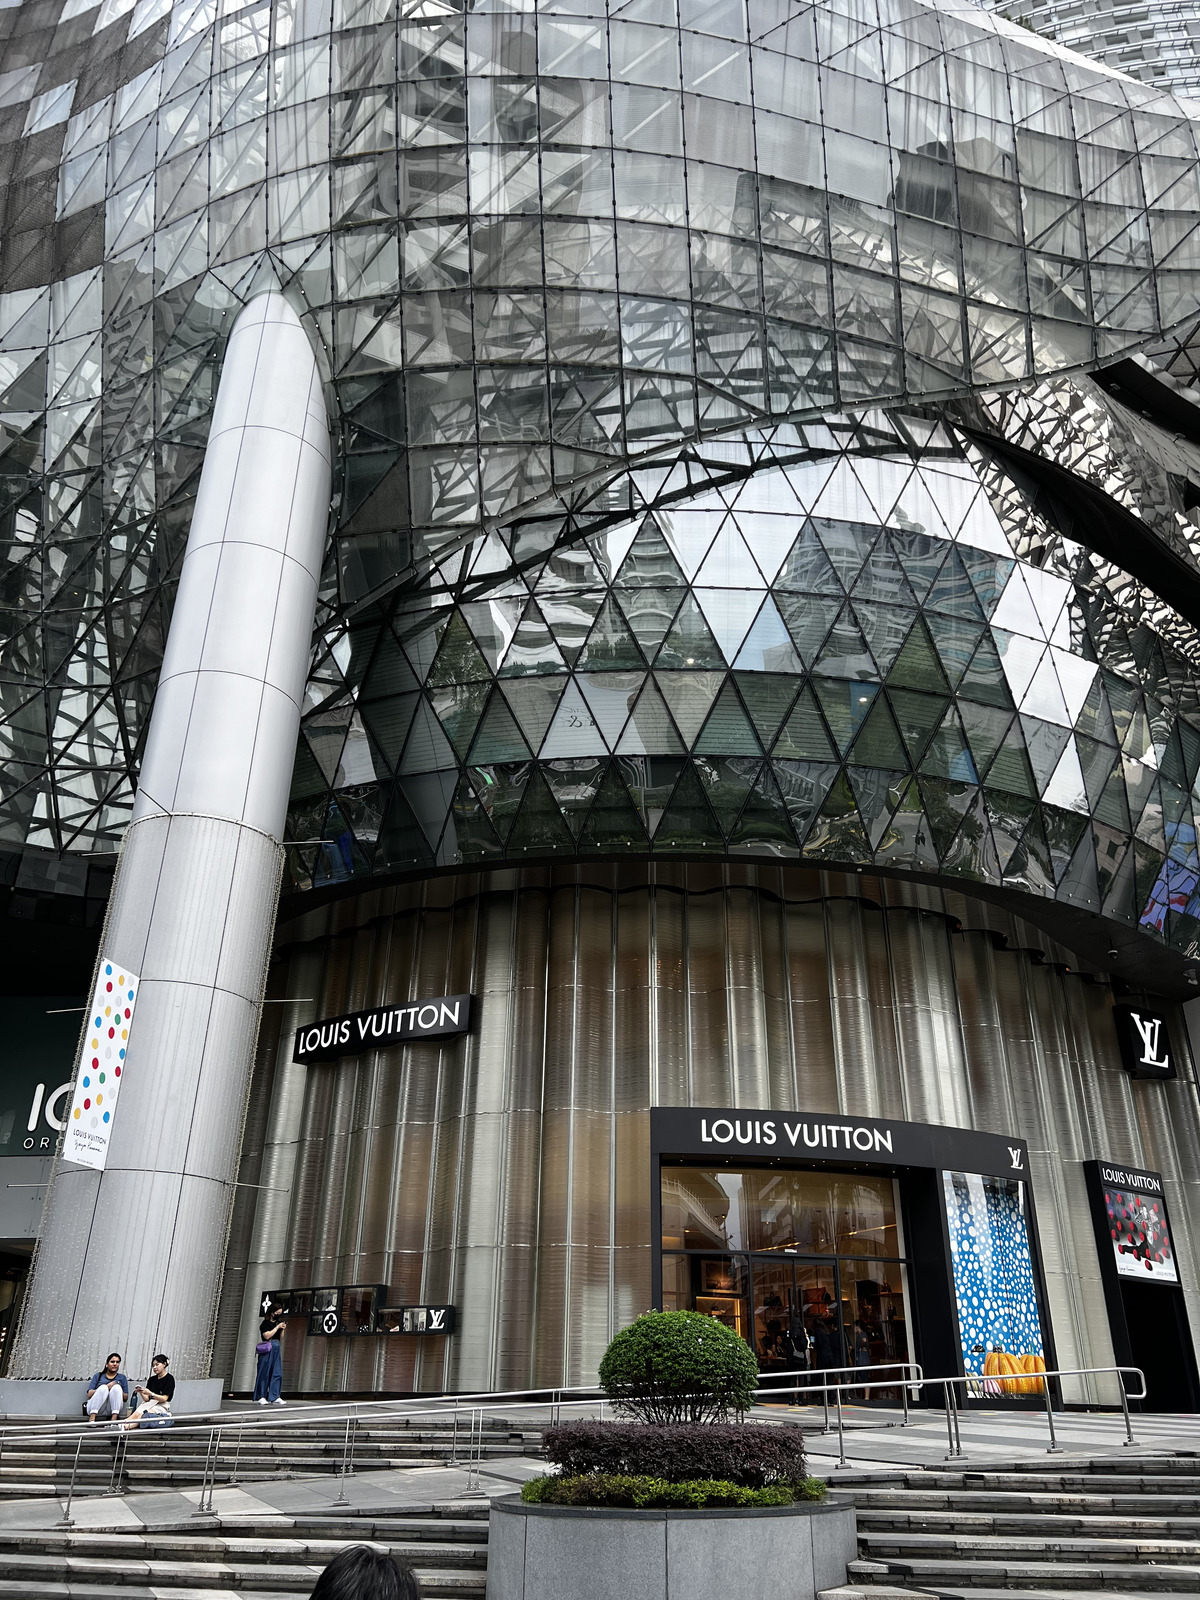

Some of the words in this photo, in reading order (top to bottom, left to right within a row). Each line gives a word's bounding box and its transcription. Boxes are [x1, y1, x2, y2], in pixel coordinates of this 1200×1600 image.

[298, 1019, 352, 1055] LOUIS
[357, 1001, 460, 1041] VUITTON
[73, 1128, 88, 1140] LOUIS
[701, 1118, 777, 1145] LOUIS
[783, 1122, 894, 1154] VUITTON
[1102, 1167, 1126, 1185] LOUIS
[1125, 1173, 1161, 1192] VUITTON
